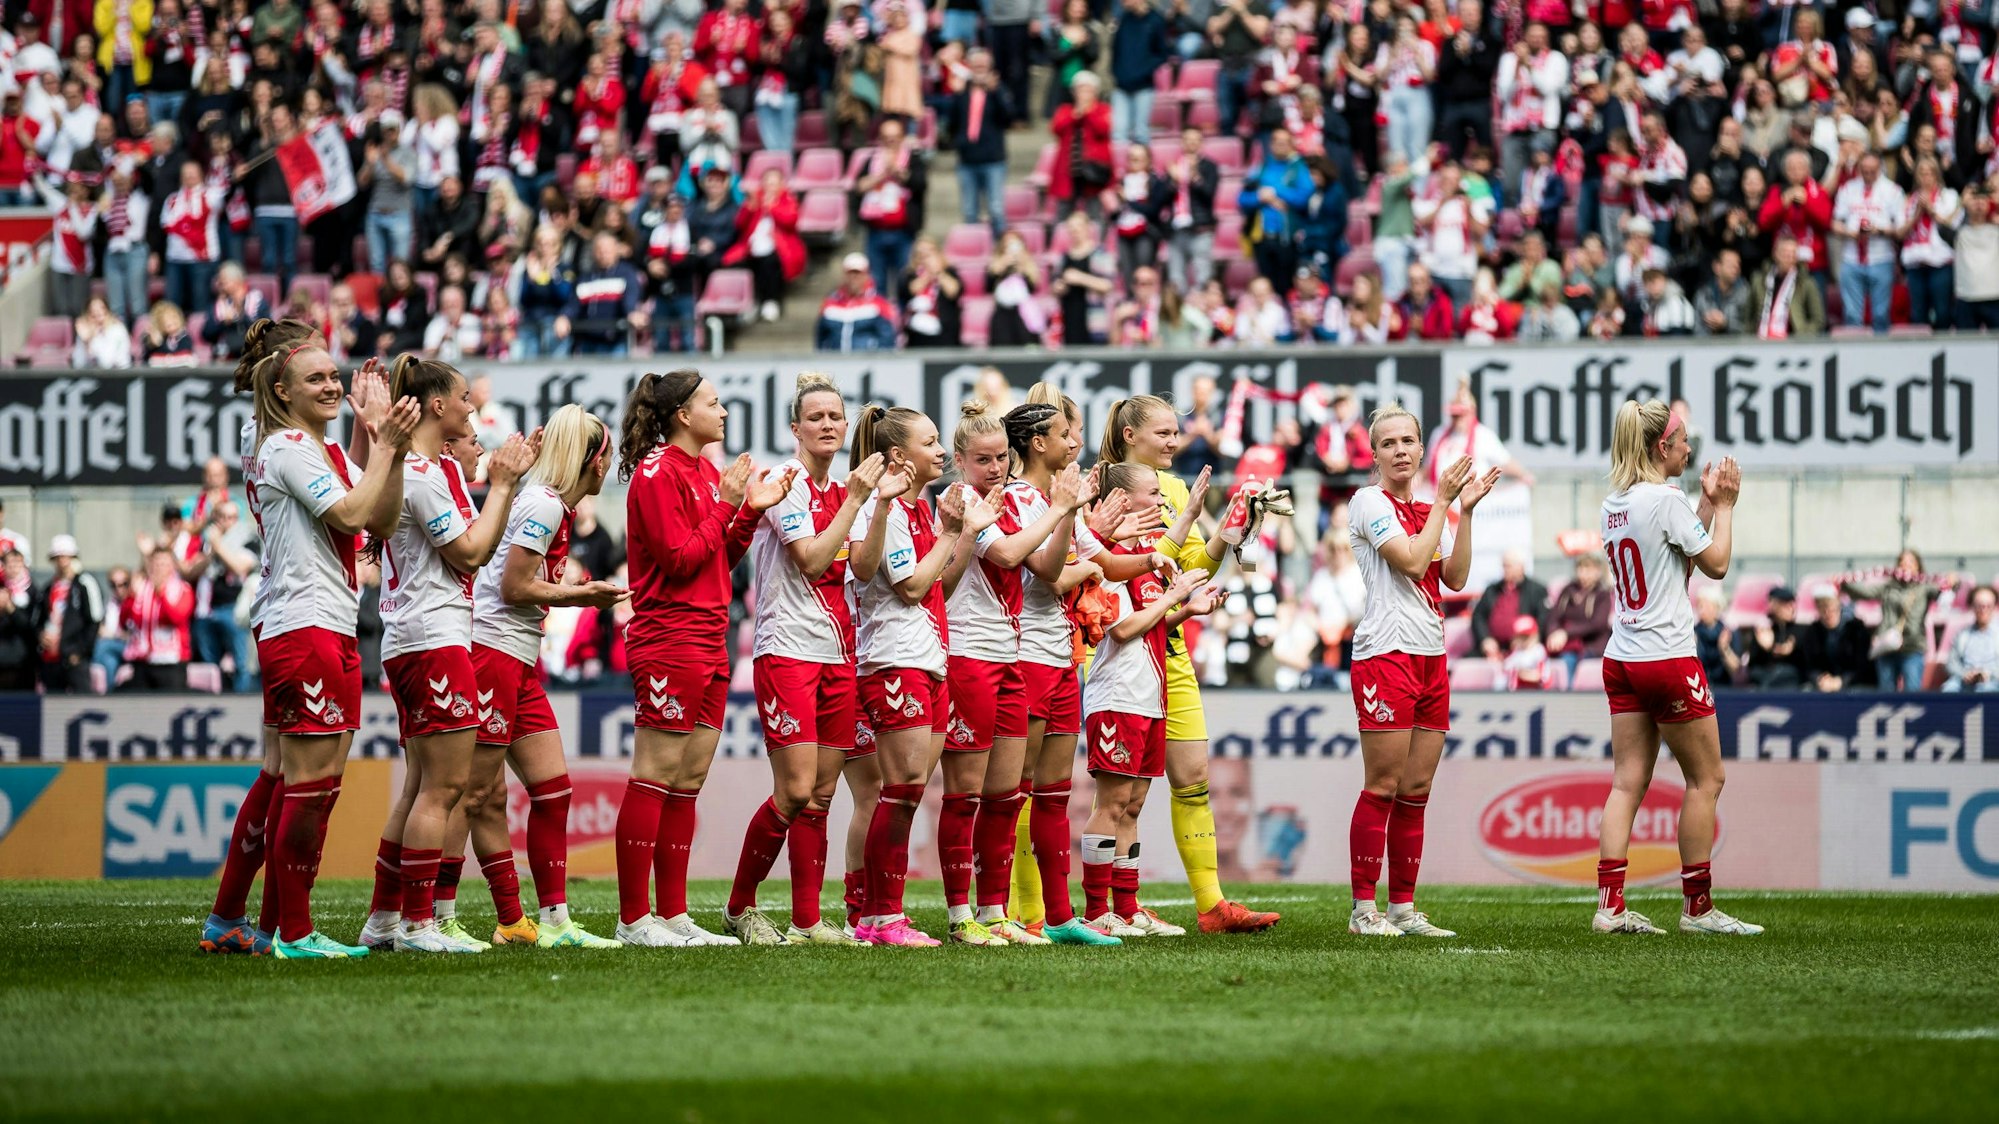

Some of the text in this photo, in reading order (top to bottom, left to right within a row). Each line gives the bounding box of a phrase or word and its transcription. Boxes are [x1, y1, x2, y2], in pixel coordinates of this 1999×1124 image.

[1714, 350, 1974, 458] Kölsch
[427, 514, 451, 536] SAP
[523, 521, 546, 538] SAP
[781, 513, 804, 530] SAP
[1607, 511, 1629, 529] BECK
[889, 551, 912, 567] SAP
[1606, 538, 1648, 612] 10
[106, 783, 240, 863] SAP
[1502, 797, 1680, 840] Schaeen
